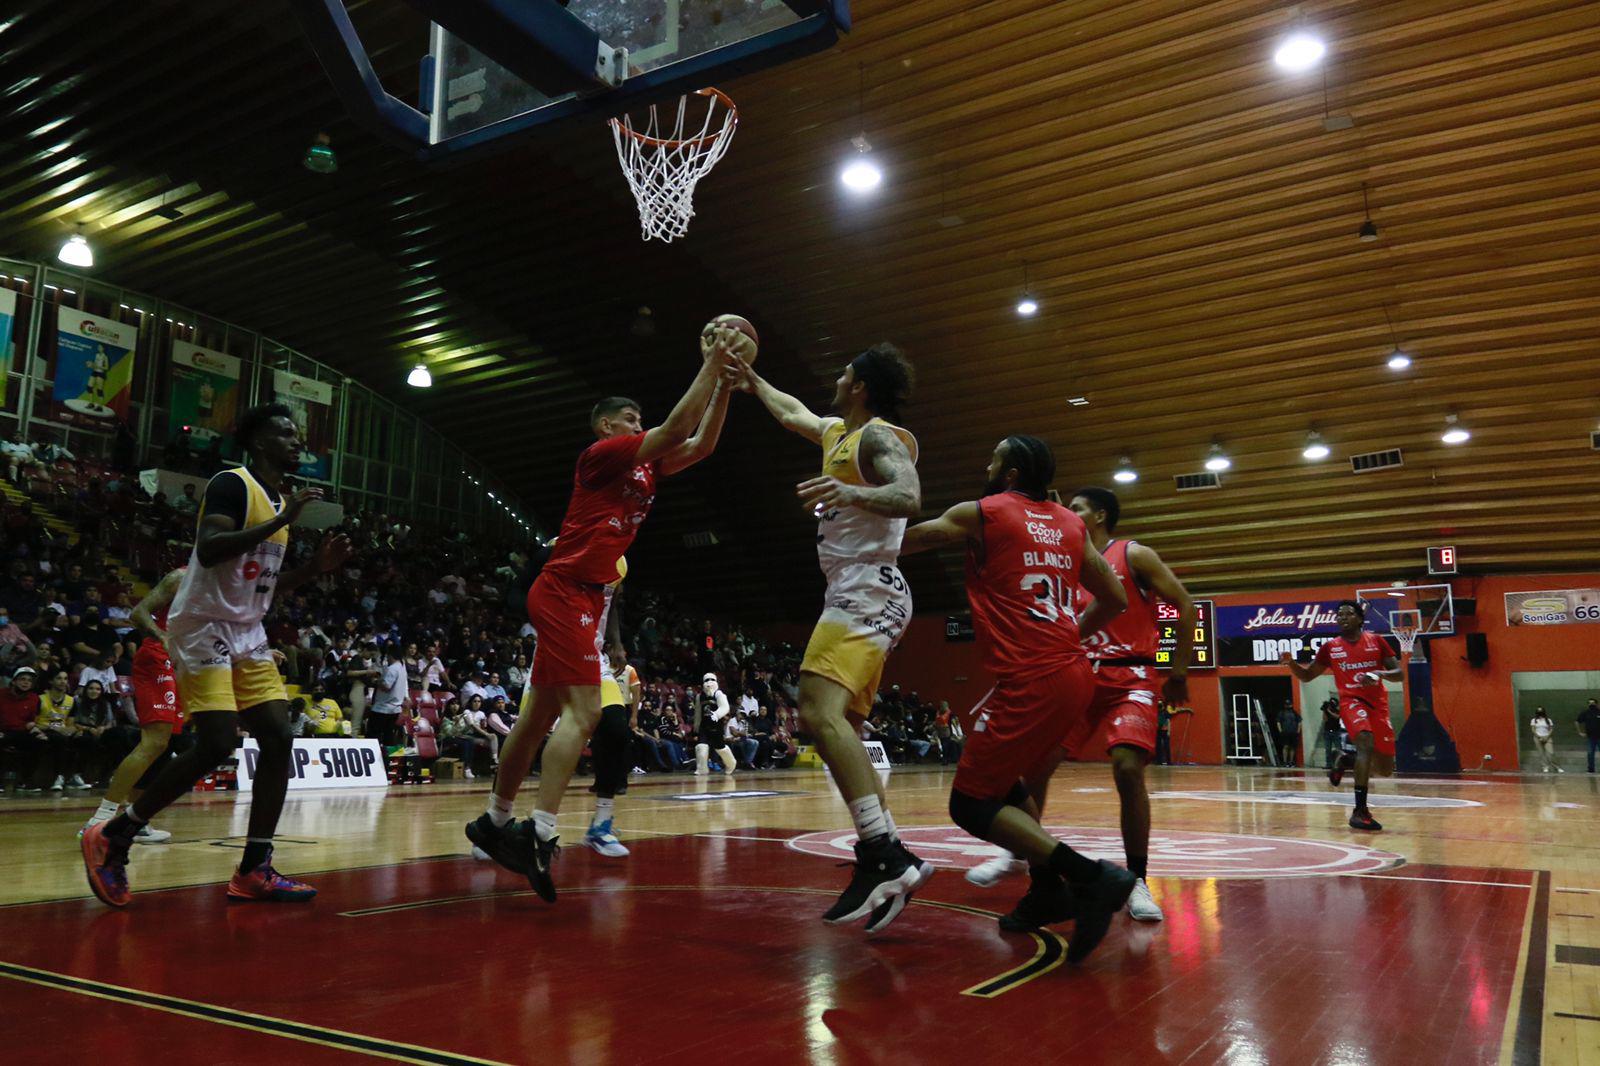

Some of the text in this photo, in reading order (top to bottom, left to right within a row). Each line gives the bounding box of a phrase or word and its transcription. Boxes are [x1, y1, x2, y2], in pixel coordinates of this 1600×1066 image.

[1025, 521, 1063, 538] Coors
[1033, 534, 1061, 546] LIGHT
[1023, 551, 1072, 570] BLANCO
[1442, 549, 1453, 564] 8
[1244, 604, 1338, 629] Salsa Huic
[1523, 614, 1566, 623] SoniGas
[1575, 605, 1600, 619] 66
[1164, 627, 1172, 638] 2
[1197, 650, 1206, 662] 0
[1252, 637, 1335, 662] DROP-S
[866, 747, 884, 763] HOP
[244, 748, 375, 779] DP-SHOP
